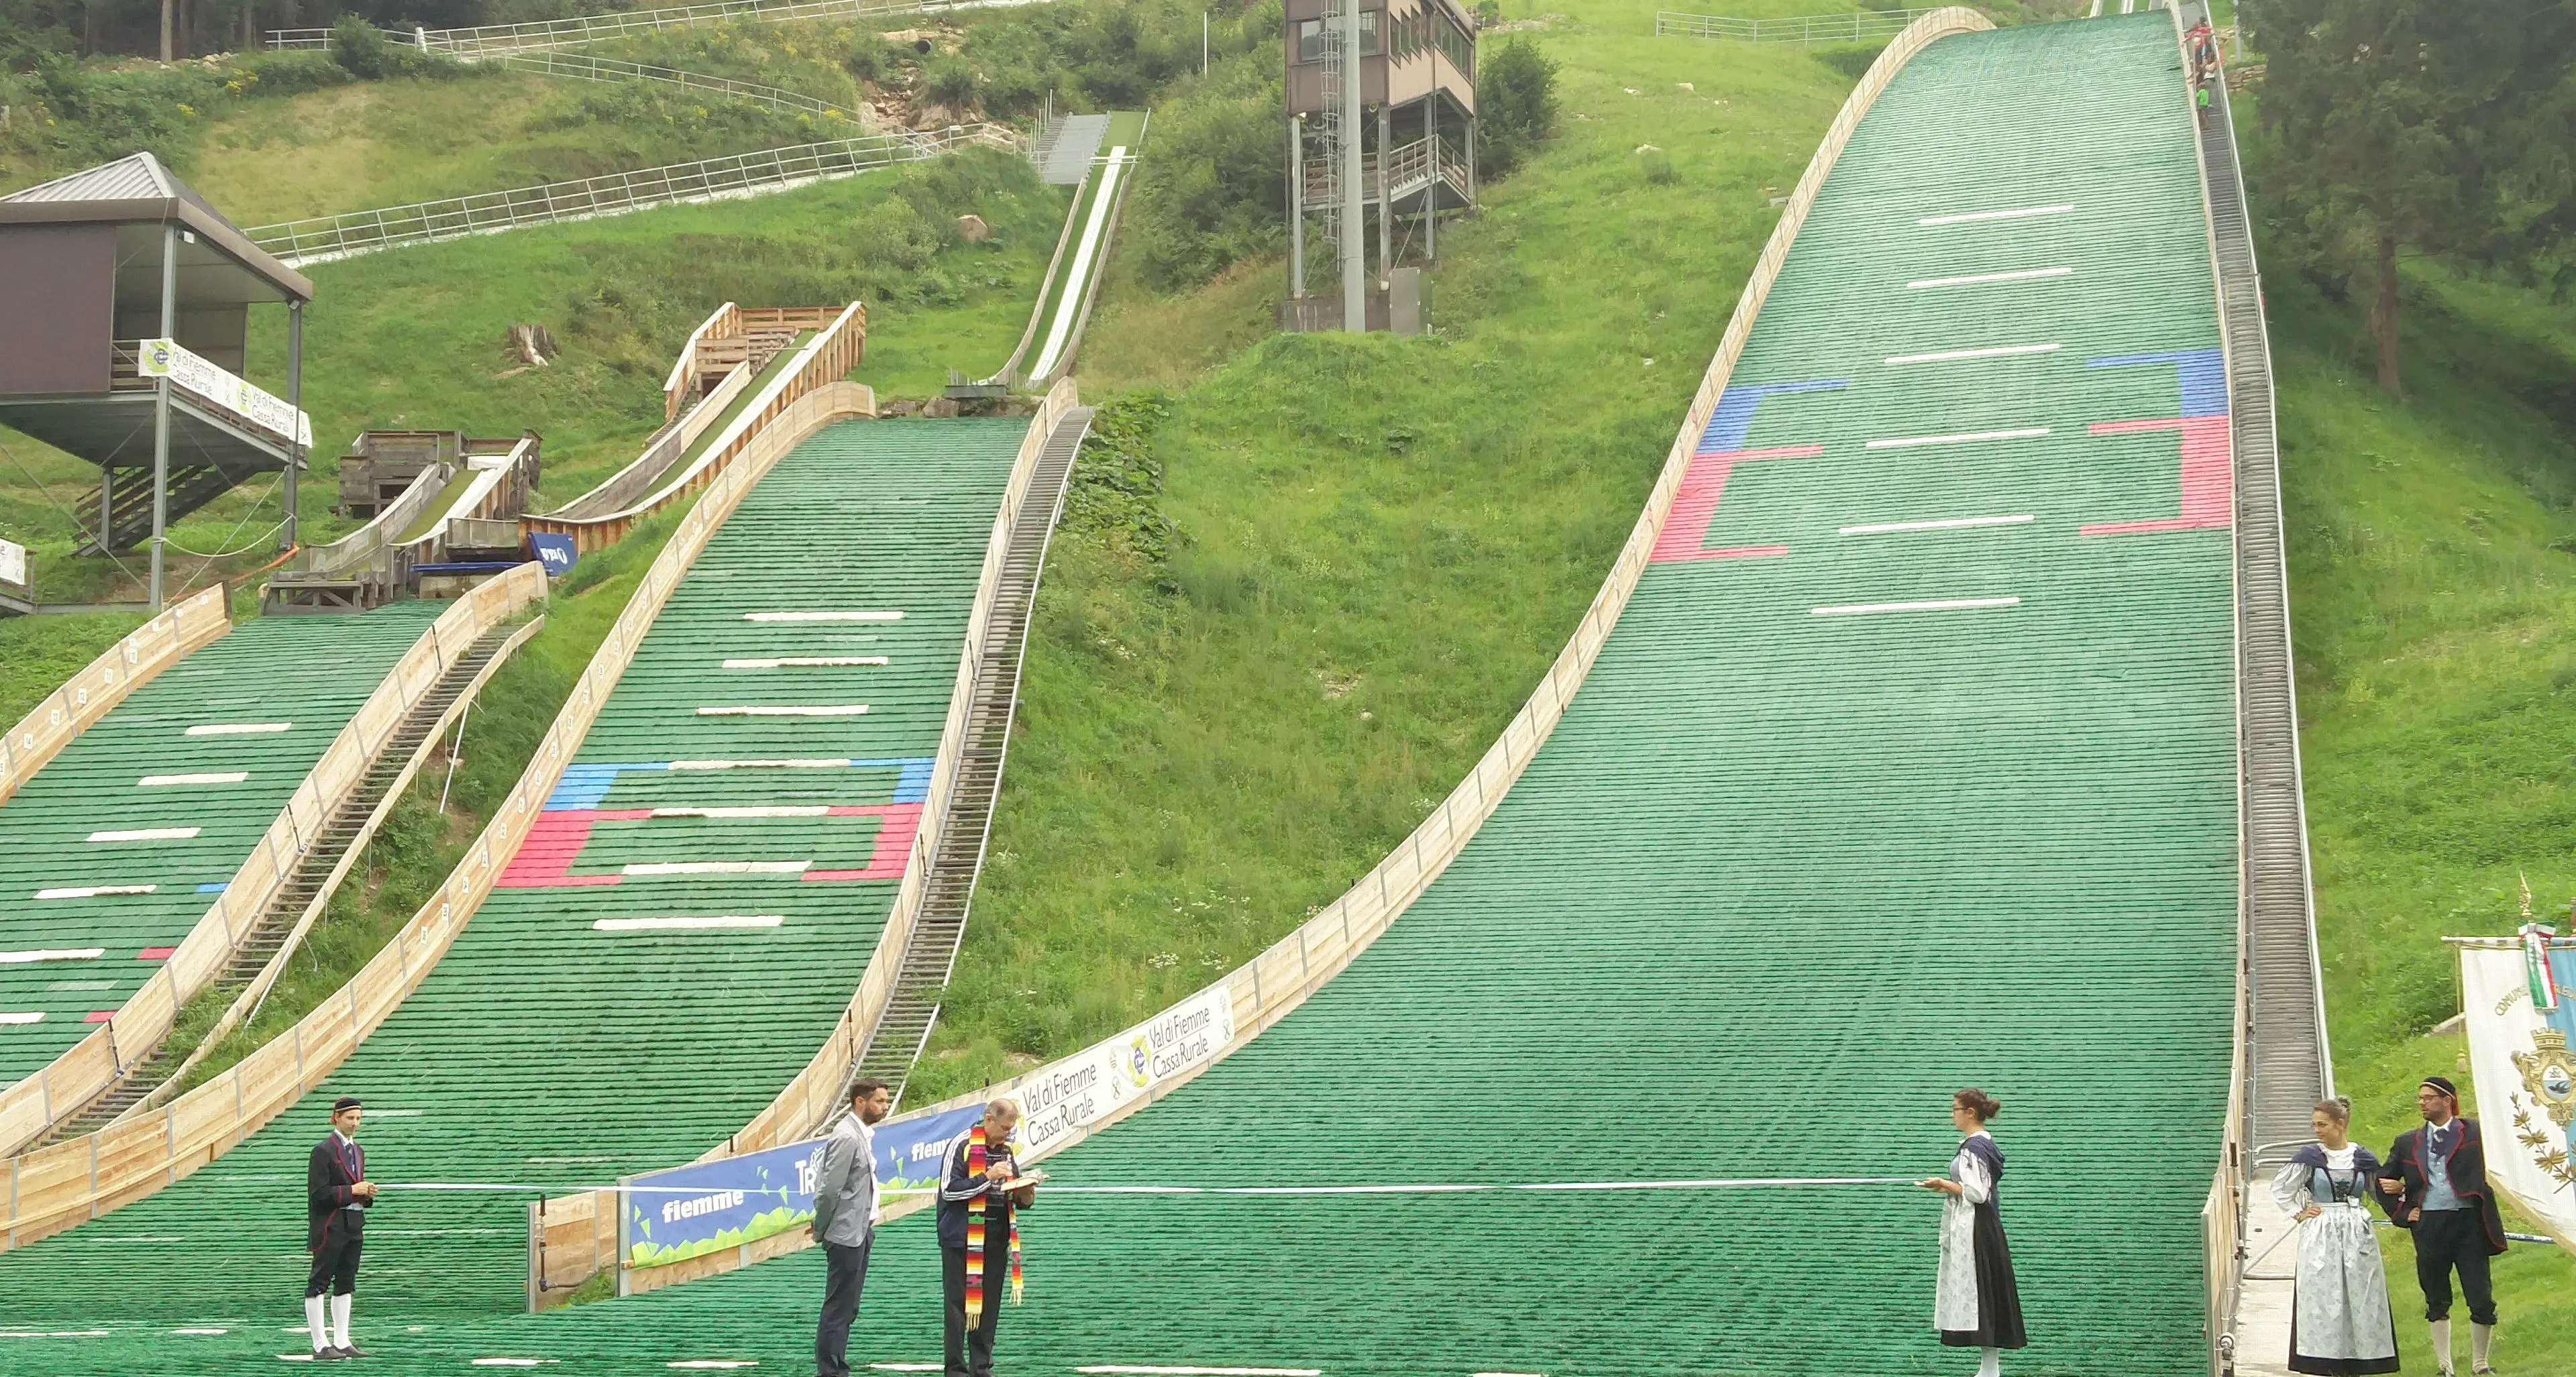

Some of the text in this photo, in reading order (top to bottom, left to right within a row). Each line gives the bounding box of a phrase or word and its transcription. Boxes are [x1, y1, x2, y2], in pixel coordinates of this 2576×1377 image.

[1149, 1007, 1210, 1050] Val di Fiemme
[1152, 1032, 1209, 1079] Cassa Rurale
[1022, 1064, 1097, 1115] Val di Fiemme
[1028, 1092, 1095, 1146] Cassa Rurale
[911, 1138, 952, 1162] fiem
[661, 1190, 745, 1224] fiemme
